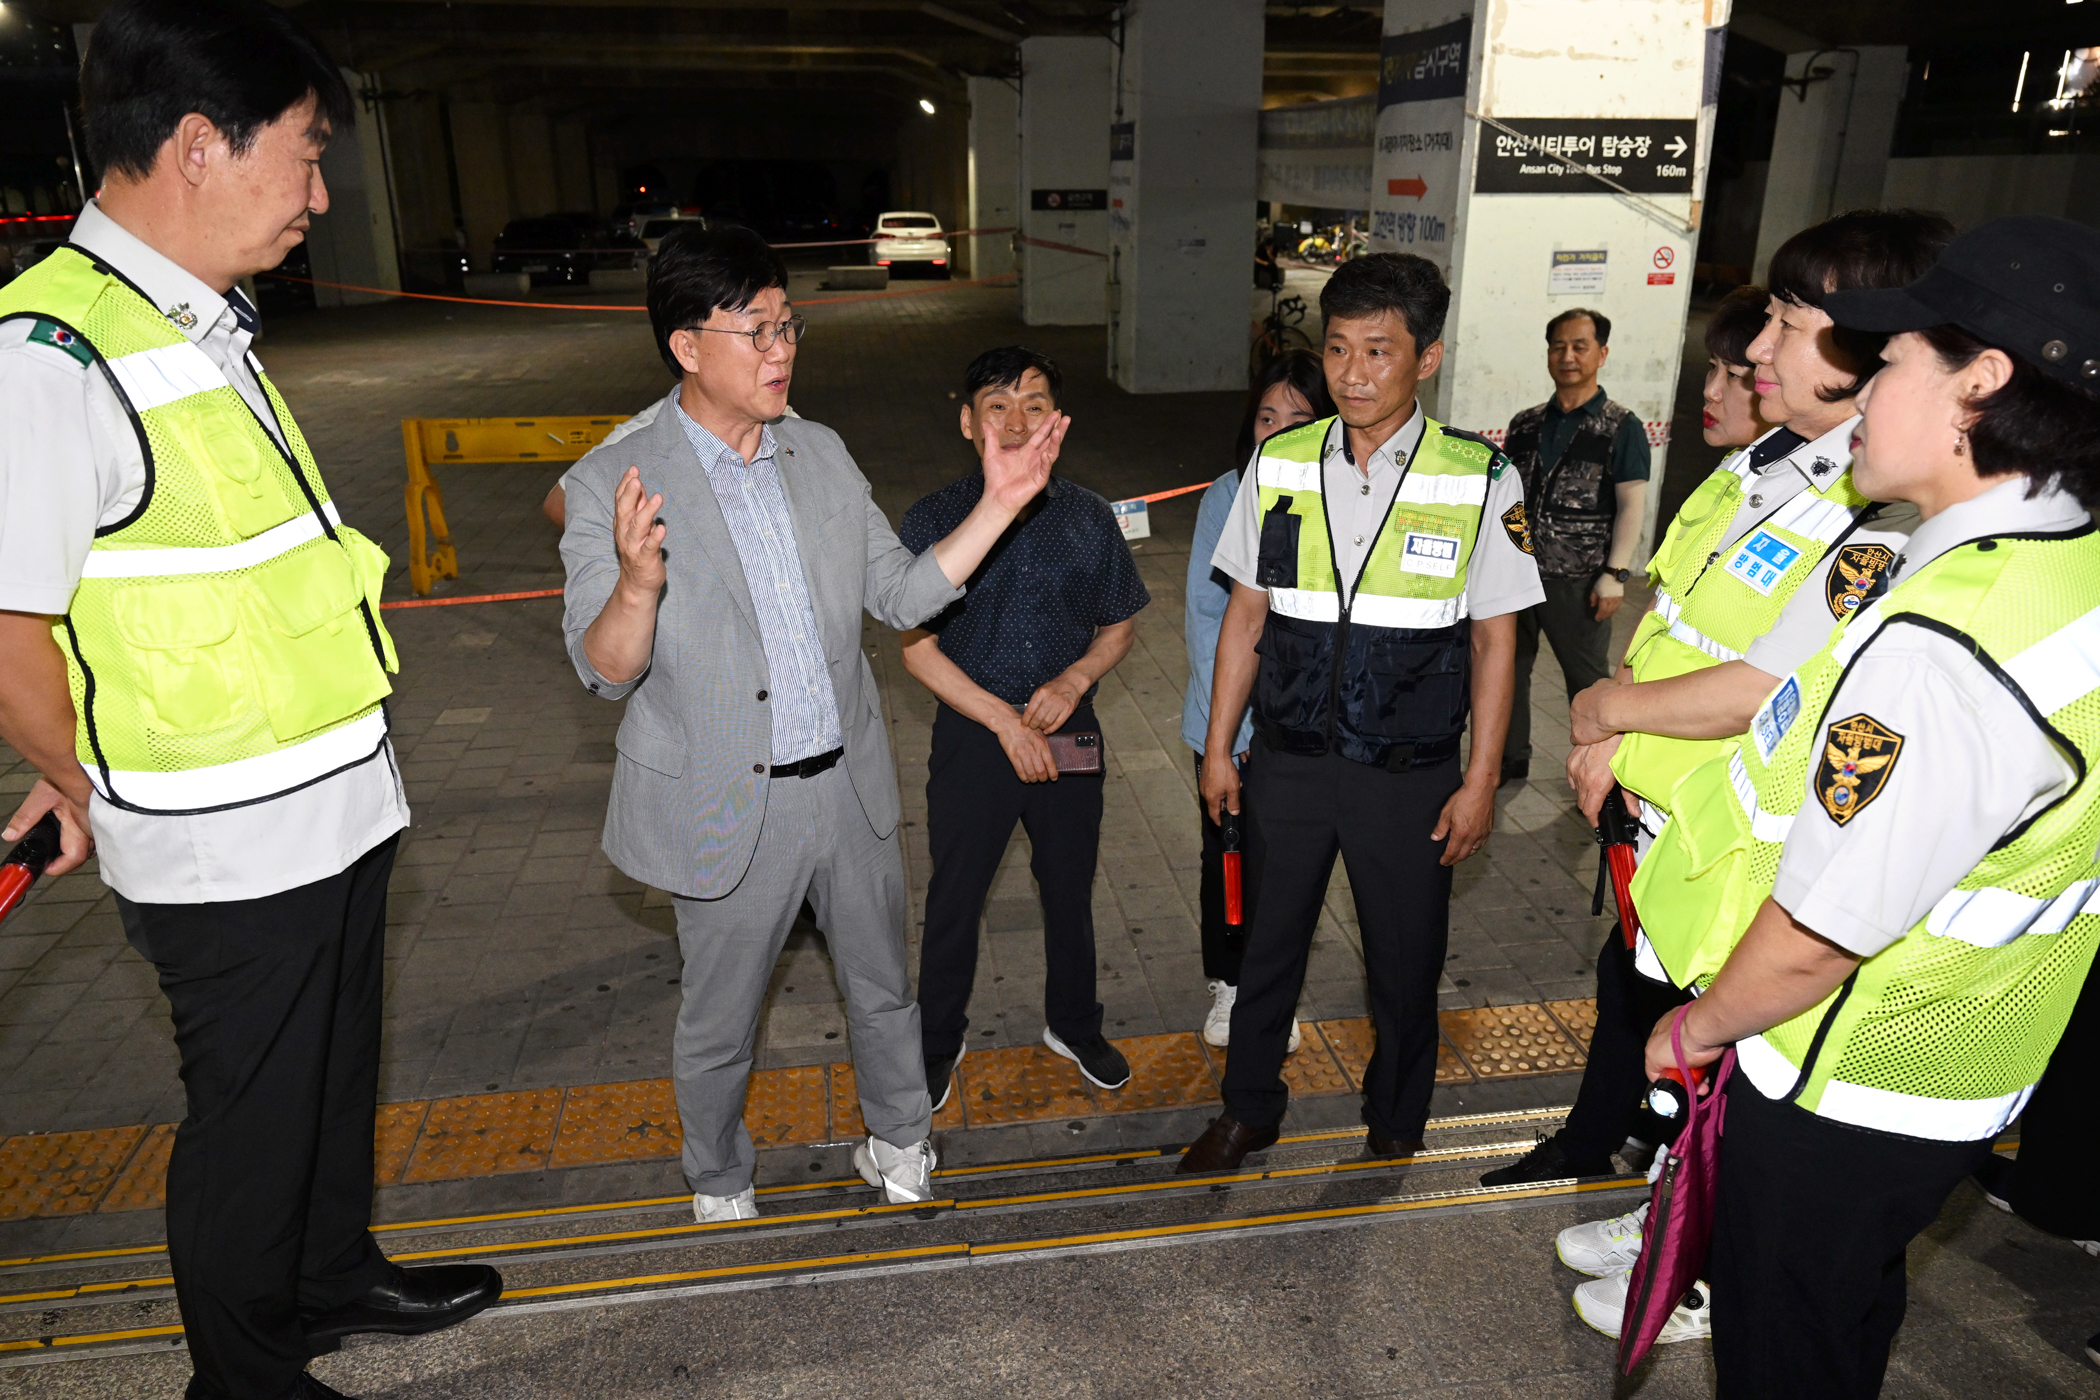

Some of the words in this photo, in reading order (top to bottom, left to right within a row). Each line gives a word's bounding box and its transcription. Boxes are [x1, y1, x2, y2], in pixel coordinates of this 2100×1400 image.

[1495, 135, 1596, 158] 안산시티투어
[1601, 135, 1652, 158] 탑승장
[1519, 163, 1545, 175] Ansan
[1547, 163, 1564, 177] City
[1586, 164, 1601, 175] Bus
[1602, 164, 1622, 177] Stop
[1656, 165, 1686, 177] 160m
[1398, 211, 1416, 244] 방향
[1419, 215, 1446, 243] 100m
[1866, 548, 1889, 561] 안산시
[1734, 552, 1777, 587] 방범대
[1849, 721, 1875, 735] 안산시
[1836, 732, 1883, 752] 자율방범대
